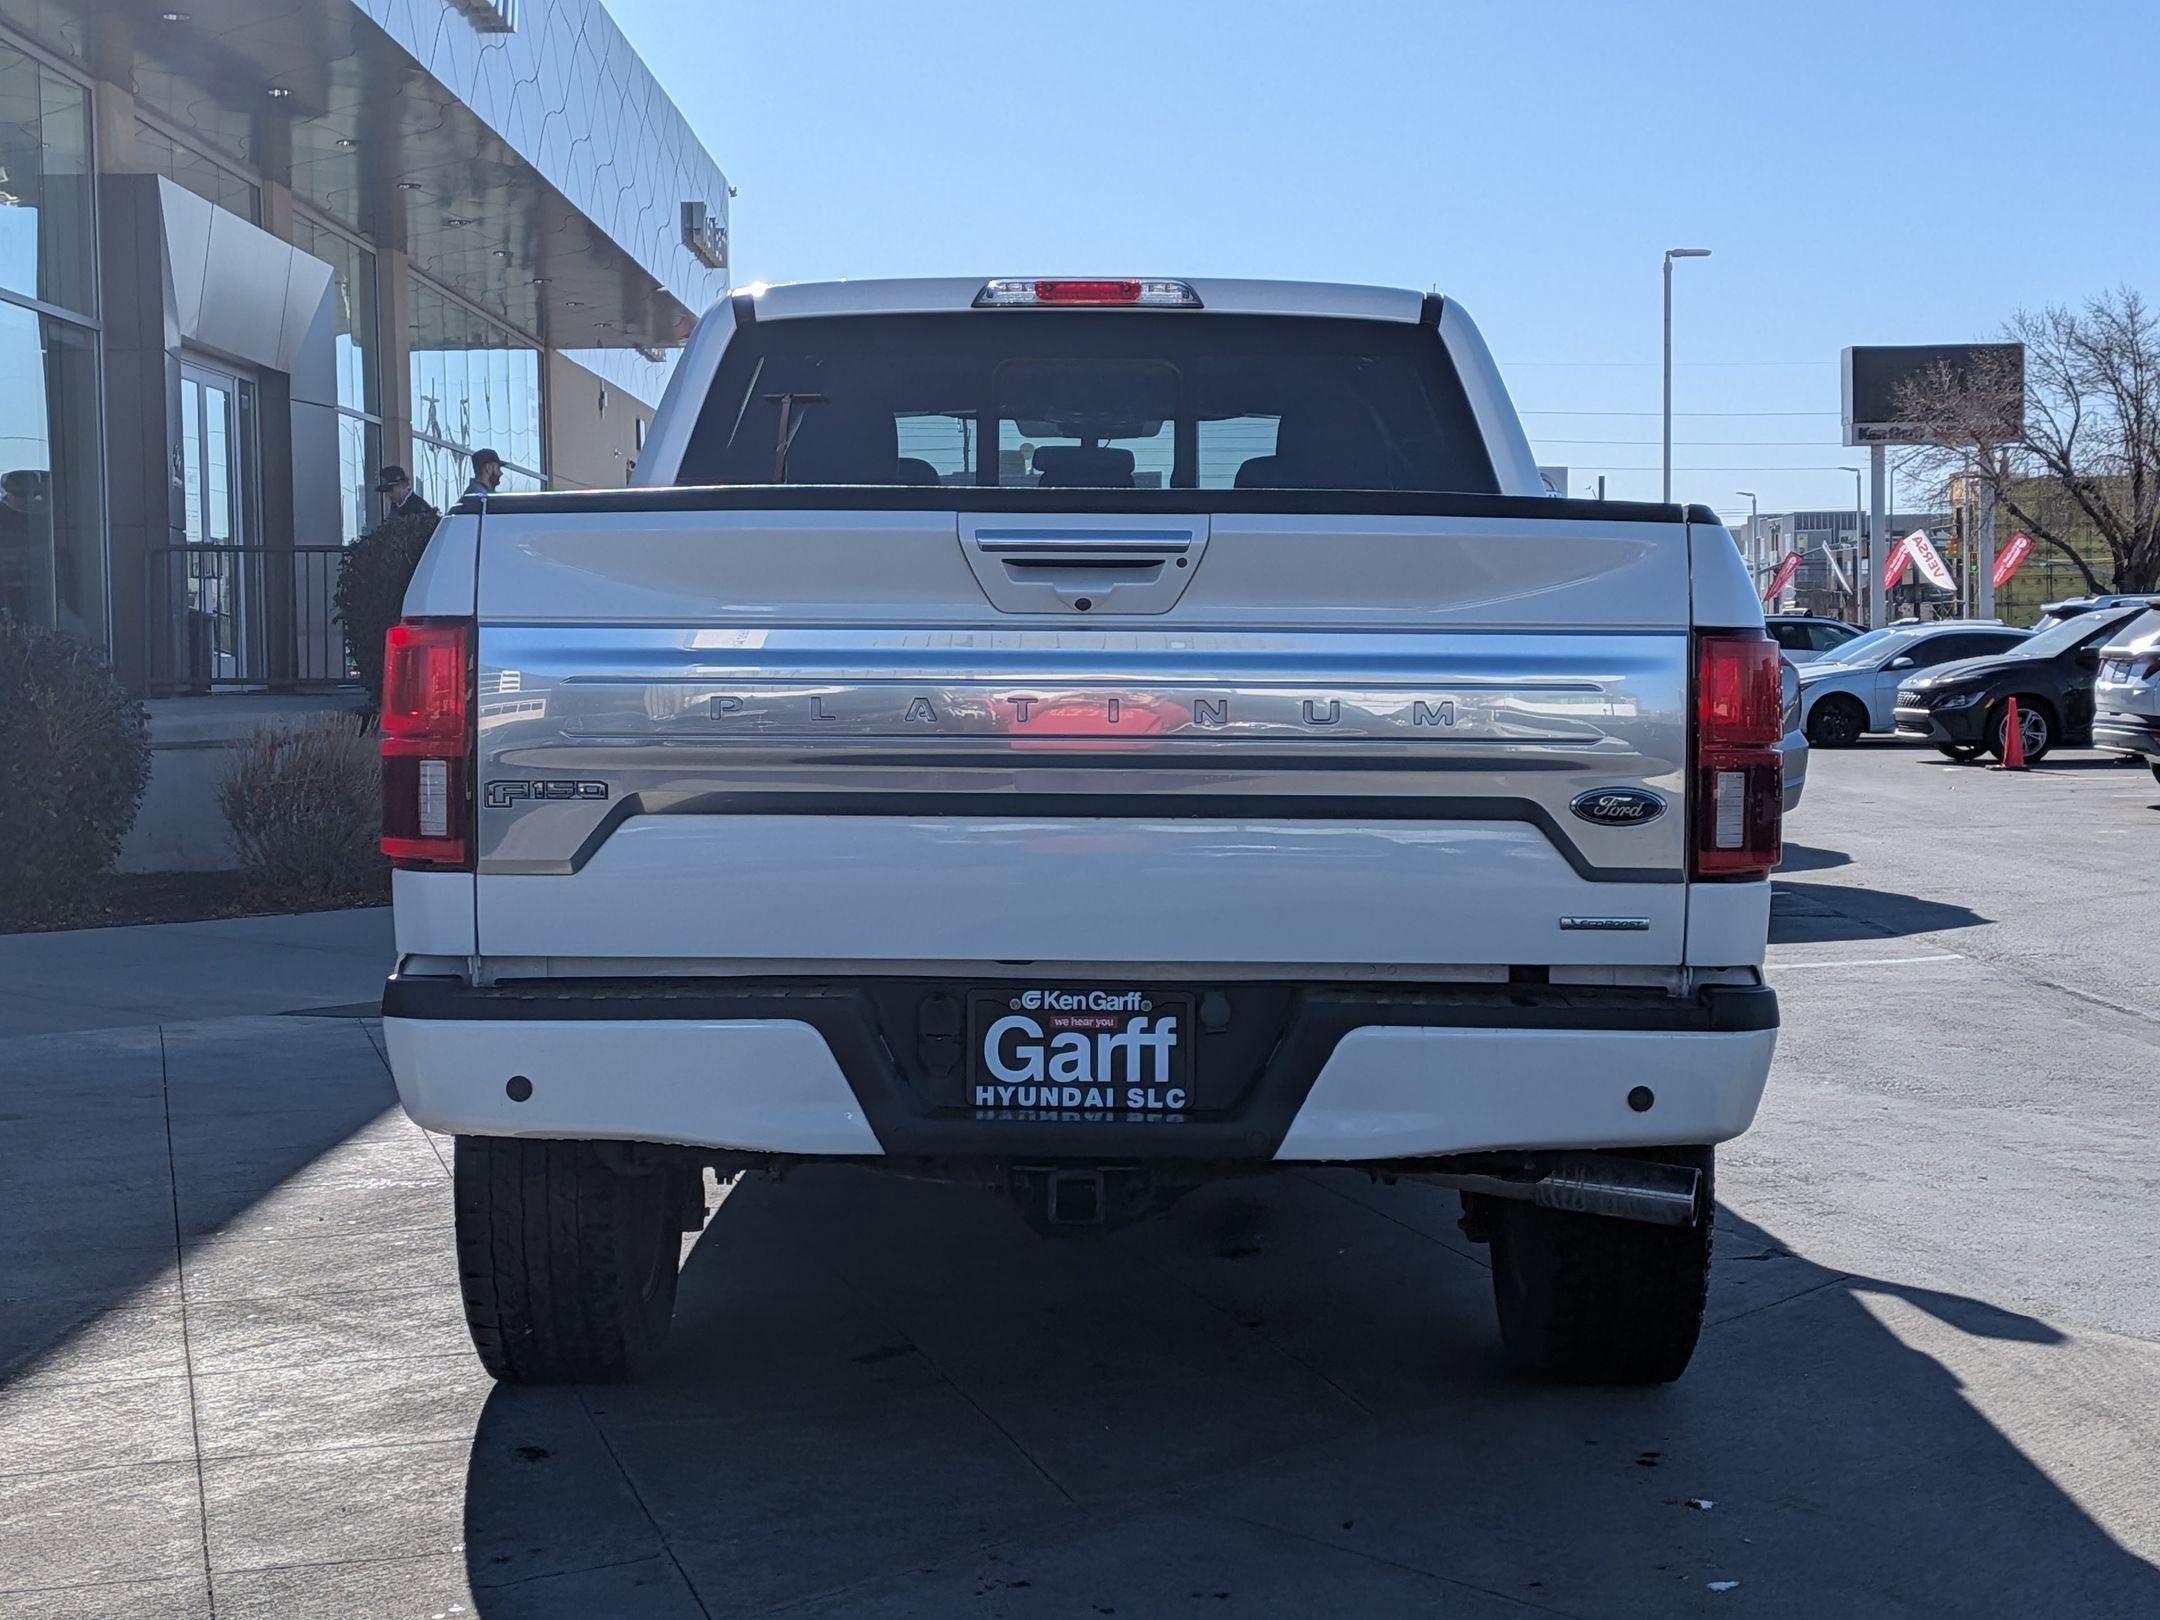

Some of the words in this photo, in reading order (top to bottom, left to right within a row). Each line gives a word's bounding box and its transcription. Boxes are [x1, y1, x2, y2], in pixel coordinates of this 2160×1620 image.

[709, 695, 1455, 726] PLATINUM
[1594, 795, 1644, 817] Ford
[1043, 990, 1086, 1010] Ken
[1089, 990, 1142, 1011] Garff
[1054, 1018, 1069, 1027] we
[1070, 1016, 1093, 1027] hear
[1095, 1017, 1114, 1030] you
[984, 1015, 1177, 1083] Garff
[975, 1085, 1114, 1107] HYUNDAI
[1127, 1087, 1186, 1109] SLC
